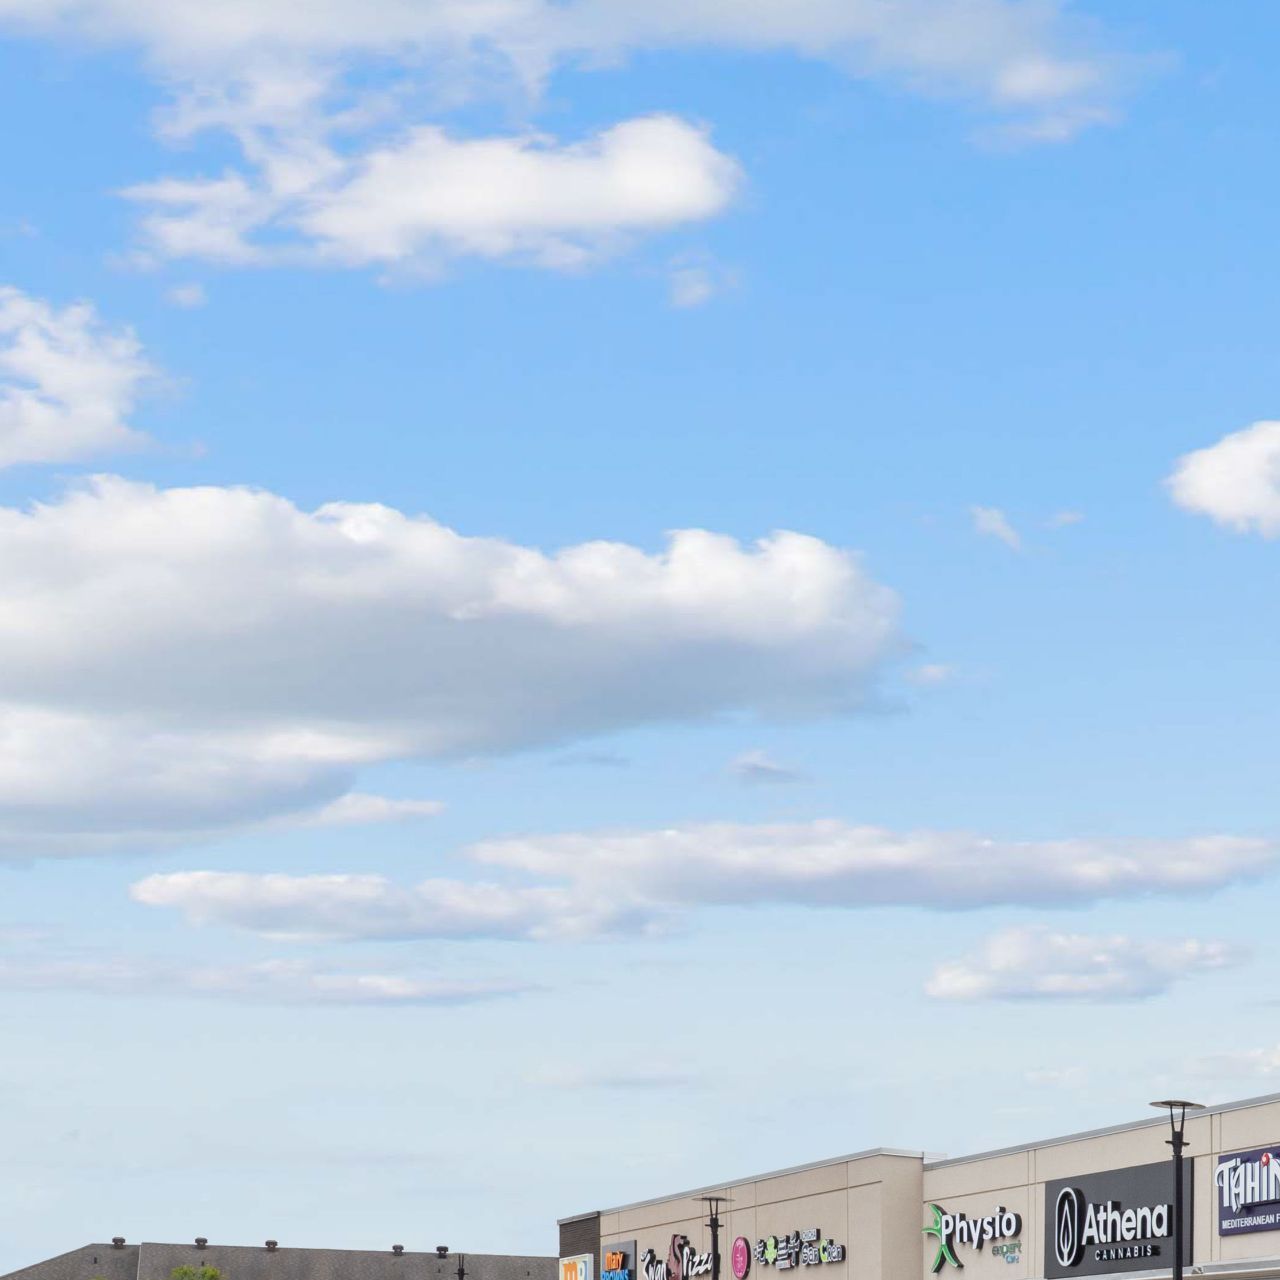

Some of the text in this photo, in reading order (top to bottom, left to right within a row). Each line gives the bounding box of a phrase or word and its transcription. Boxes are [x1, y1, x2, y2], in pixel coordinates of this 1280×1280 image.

[941, 1206, 1018, 1250] Physio
[1081, 1200, 1169, 1246] Athena
[1221, 1212, 1275, 1230] MEDITERRANEAN
[1094, 1245, 1153, 1261] CANNABIS
